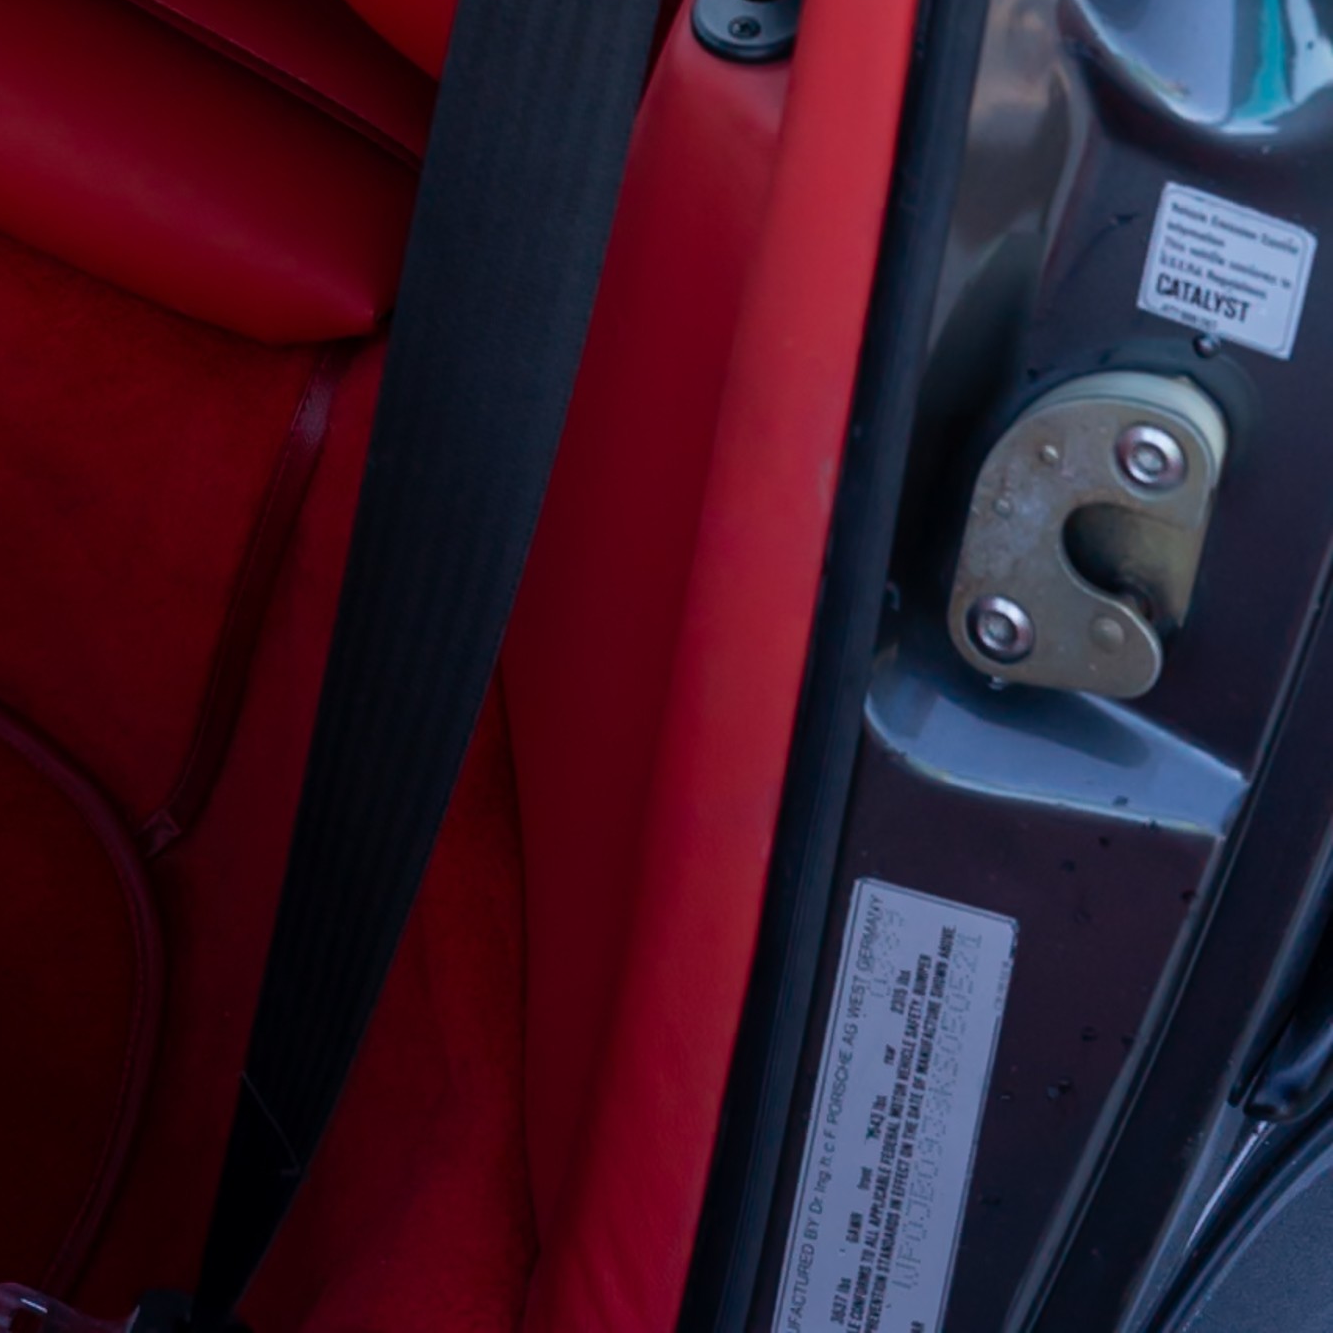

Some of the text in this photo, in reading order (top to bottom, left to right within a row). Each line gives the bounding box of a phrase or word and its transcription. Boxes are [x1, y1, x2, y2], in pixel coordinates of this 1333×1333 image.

[1156, 272, 1250, 323] CATALYST
[854, 892, 882, 972] GERMANY
[911, 952, 932, 996] BUMPER
[928, 960, 949, 999] SHOWN
[845, 974, 867, 1020] WEST
[840, 1021, 858, 1046] AG
[914, 999, 941, 1075] MANUFACTURE
[895, 1039, 915, 1081] VEHICLE
[825, 1049, 853, 1125] PORSCHE
[887, 1081, 907, 1119] MOTOR
[911, 1075, 927, 1091] OF
[905, 1091, 924, 1120] DATE
[878, 1120, 900, 1165] FEDERAL
[898, 1141, 914, 1158] ON
[901, 1119, 918, 1141] THE
[867, 1165, 891, 1227] APPLICABLE
[890, 1157, 911, 1197] EFFECT
[888, 1197, 903, 1212] IN
[803, 1216, 821, 1240] BY
[863, 1228, 879, 1248] ALL
[876, 1210, 901, 1273] STANDARDS
[860, 1247, 875, 1264] TO
[849, 1263, 872, 1321] CONFORMS
